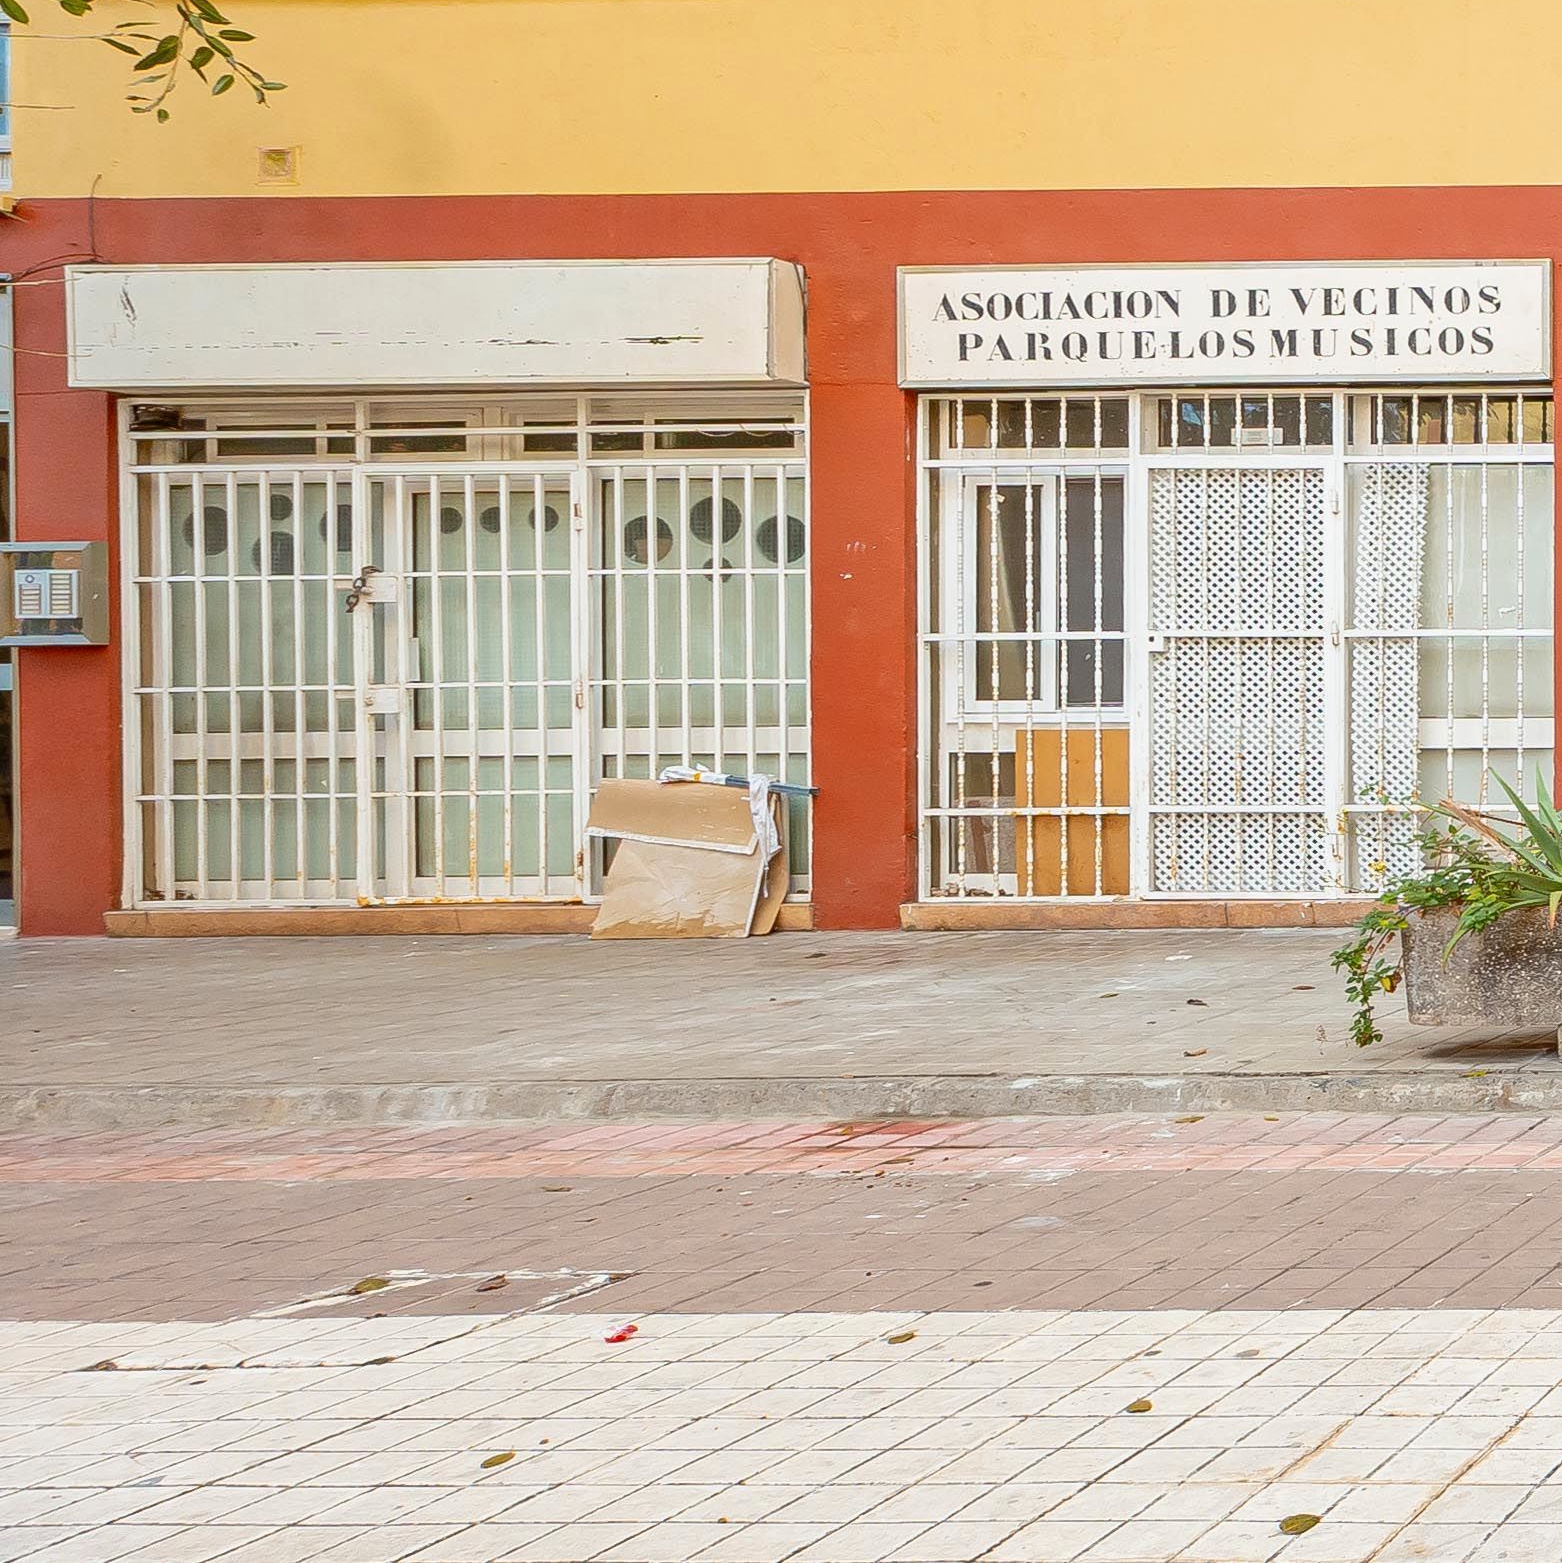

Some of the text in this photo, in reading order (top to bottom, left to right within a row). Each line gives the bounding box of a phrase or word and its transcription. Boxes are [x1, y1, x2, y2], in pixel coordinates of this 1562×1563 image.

[931, 285, 1502, 322] ASOCIACION DE VECINOS
[1269, 326, 1494, 358] MUSICOS
